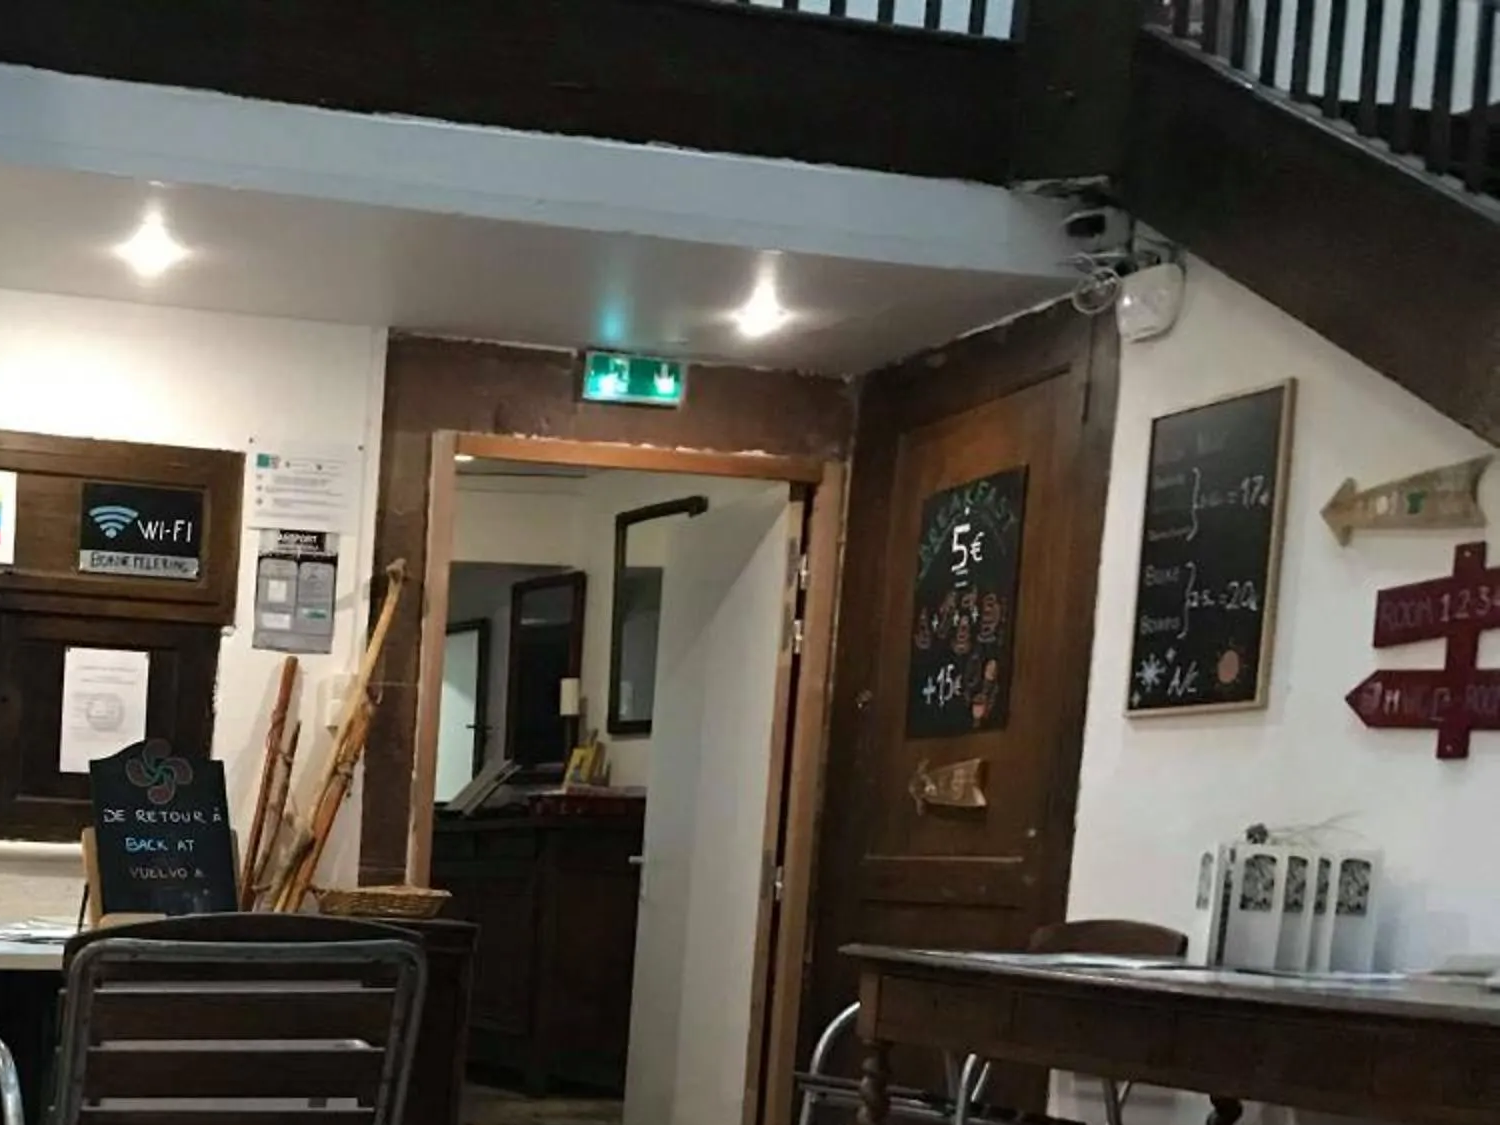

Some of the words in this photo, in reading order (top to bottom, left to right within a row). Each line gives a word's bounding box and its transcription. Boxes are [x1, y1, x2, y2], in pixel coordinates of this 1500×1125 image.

[137, 519, 193, 543] WI-FI
[951, 523, 985, 572] 5€
[102, 807, 127, 824] DE
[135, 808, 207, 824] RETOUR
[124, 836, 169, 853] BACK
[177, 838, 196, 853] AT
[128, 866, 188, 881] VUELVO
